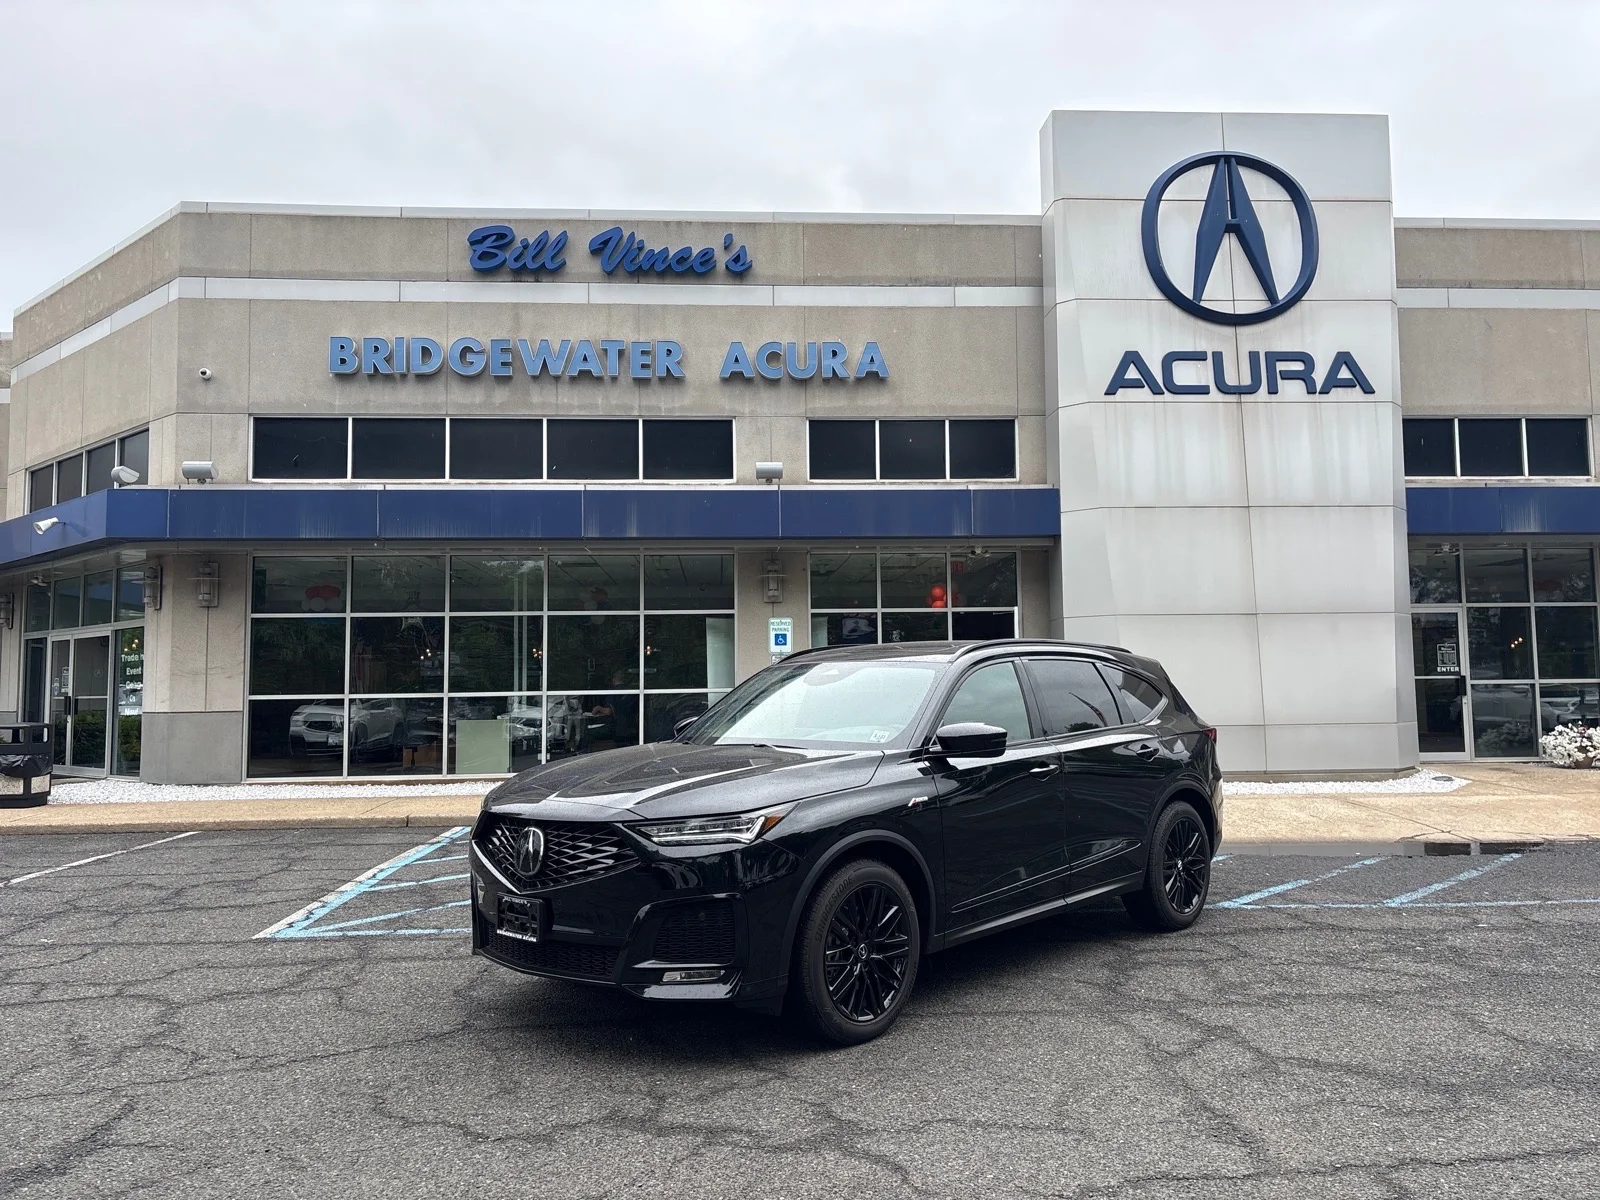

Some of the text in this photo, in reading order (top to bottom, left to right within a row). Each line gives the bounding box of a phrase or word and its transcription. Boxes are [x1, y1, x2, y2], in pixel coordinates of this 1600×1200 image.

[467, 224, 753, 276] Bill Vince's
[328, 336, 891, 380] BRIDGEWATER ACURA
[1104, 350, 1376, 395] ACURA
[121, 654, 139, 662] Trade
[815, 876, 853, 944] BRIDGESTONE
